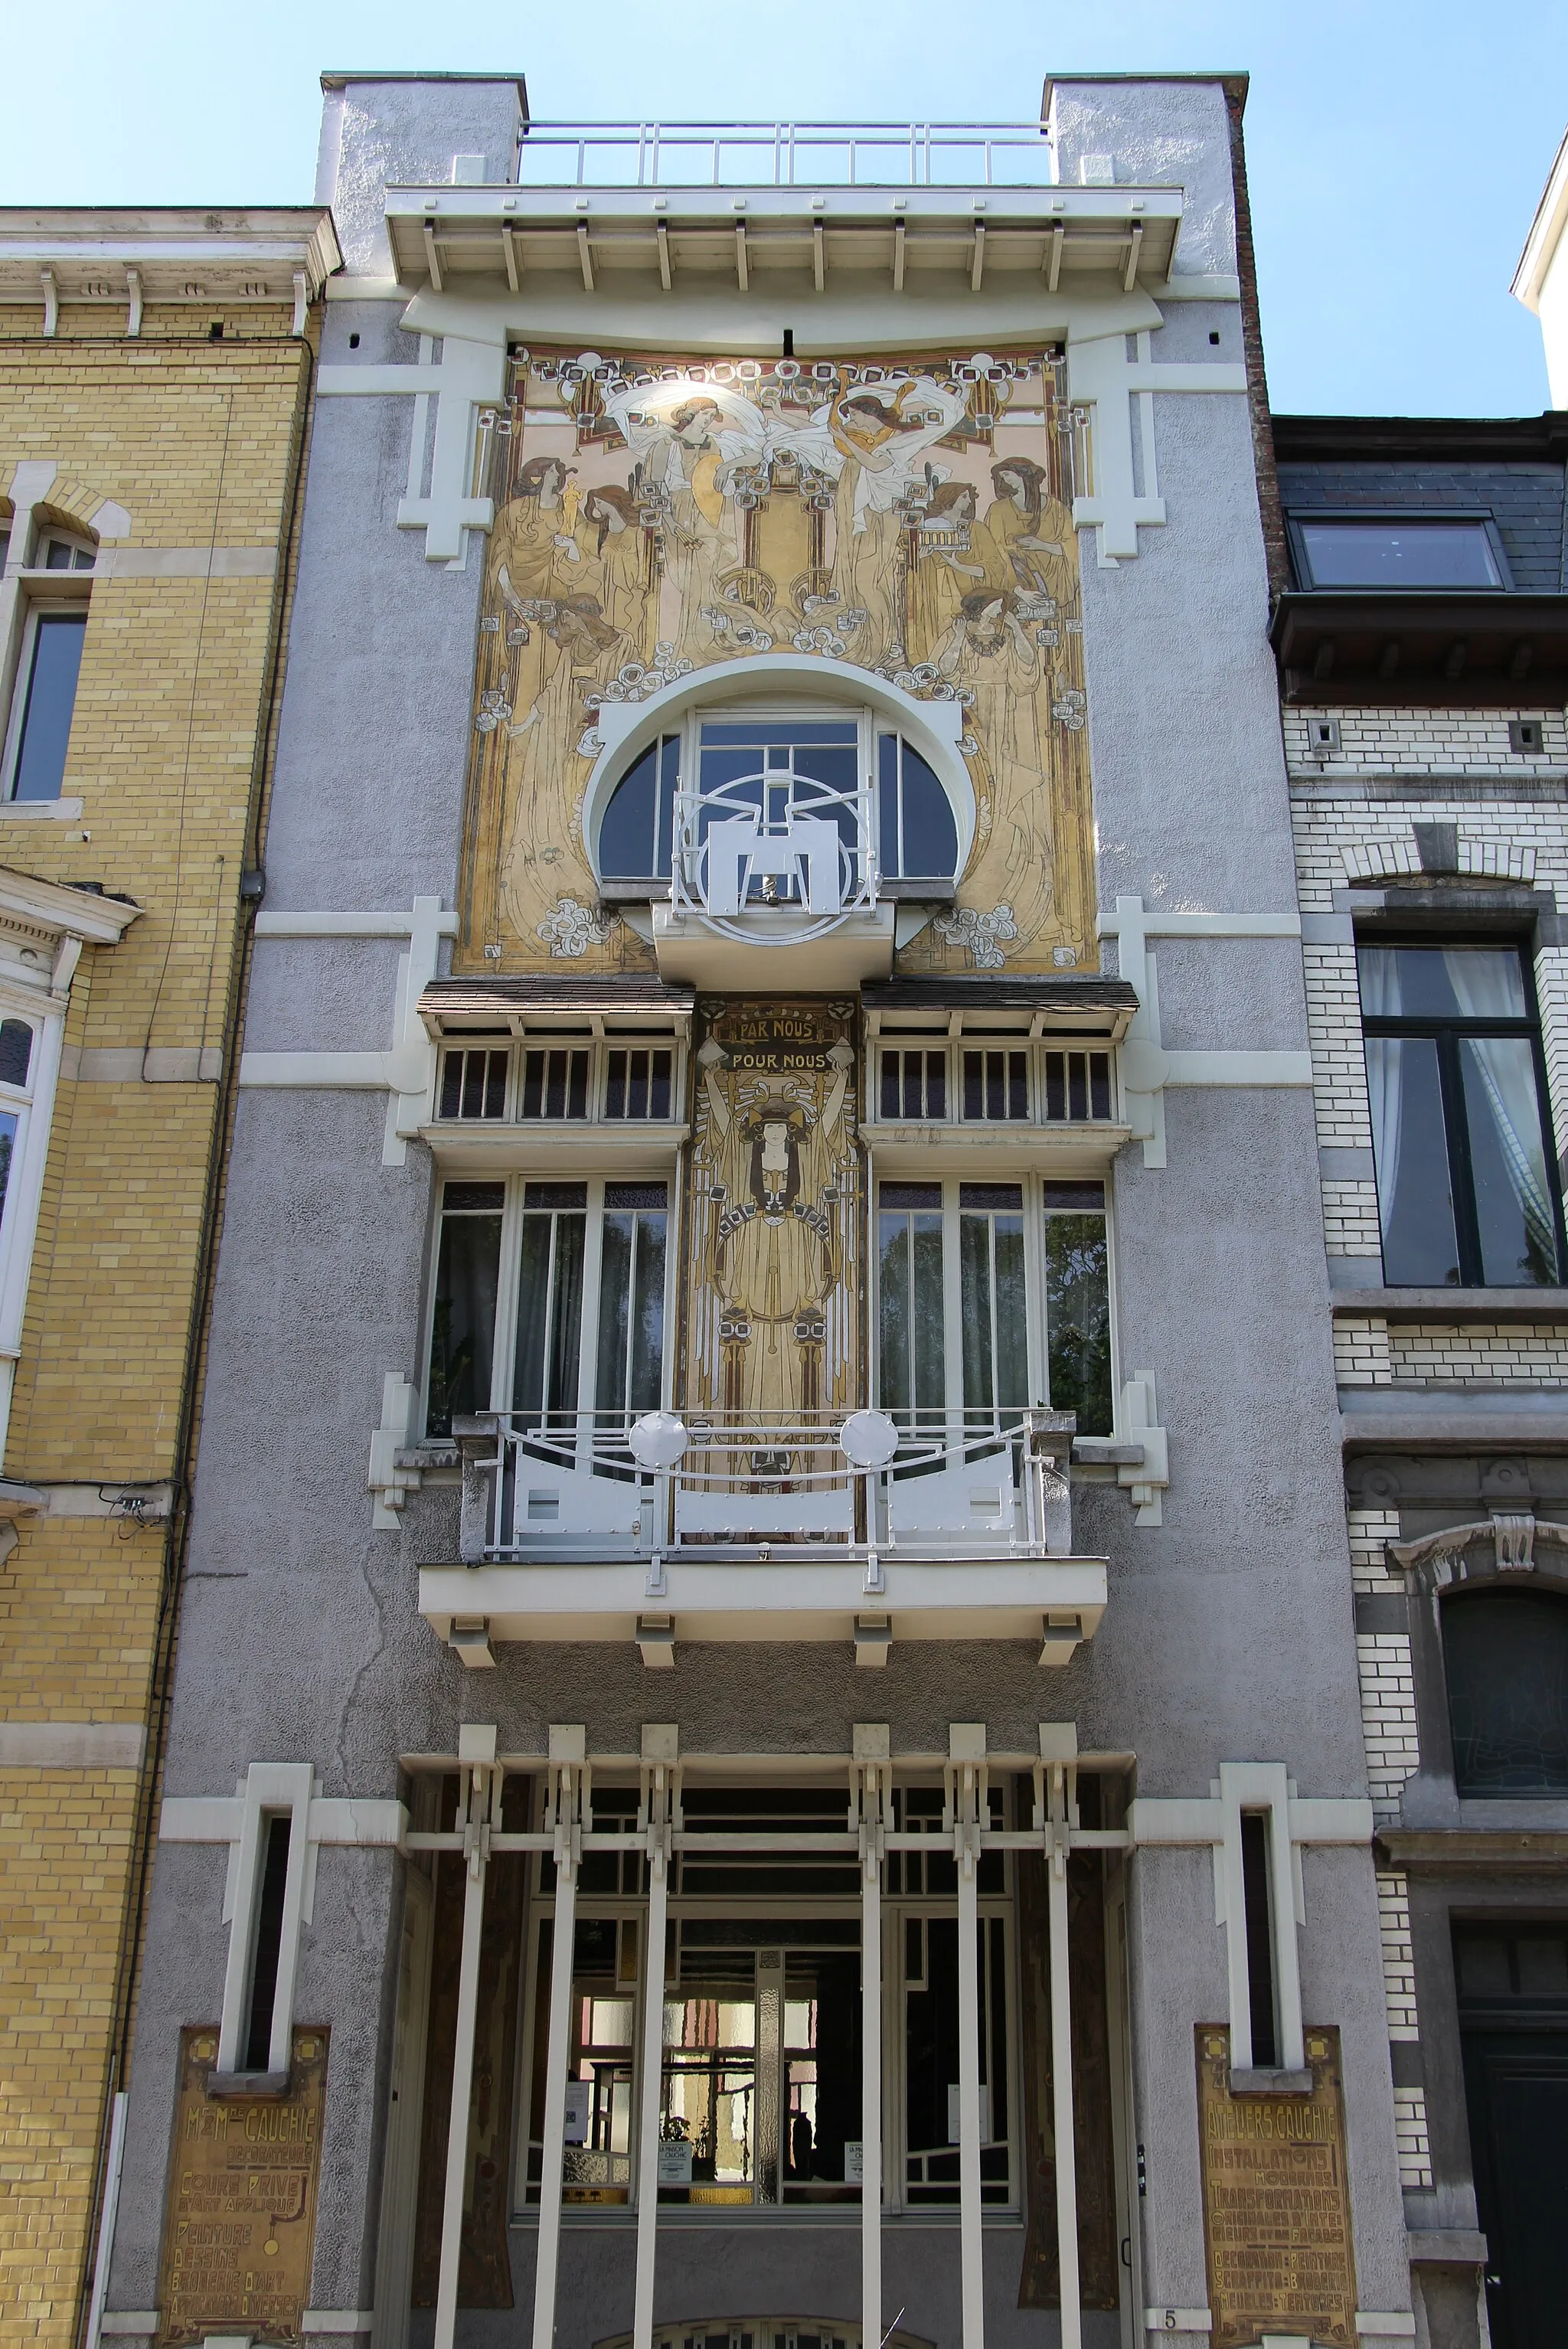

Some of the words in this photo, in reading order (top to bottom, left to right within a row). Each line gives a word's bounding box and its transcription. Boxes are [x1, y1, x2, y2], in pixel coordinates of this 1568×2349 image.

[741, 1021, 769, 1037] PAR
[773, 1020, 813, 1037] NOUS
[733, 1054, 779, 1068] POUR
[783, 1054, 825, 1068] NOUS
[245, 2106, 315, 2142] CAUCHIE
[1207, 2100, 1272, 2140] ATELIERS
[1276, 2105, 1337, 2142] CAUCHIE
[227, 2145, 312, 2164] DECORATEURS
[1208, 2145, 1328, 2171] INSTALLATIONS
[181, 2171, 240, 2196] COURS
[1255, 2171, 1332, 2187] MODERNES
[179, 2193, 221, 2212] D'ART
[225, 2197, 296, 2213] APPLIQUE
[1210, 2179, 1341, 2211] TRANSFORMATIONS
[1211, 2211, 1289, 2226] ORIGINALES
[175, 2218, 252, 2245] PEINTURE
[1213, 2226, 1257, 2243] RIEURS
[1292, 2228, 1344, 2244] FACADES
[174, 2247, 240, 2269] DESSINS
[1290, 2252, 1346, 2271] PEINTURE
[171, 2271, 241, 2292] BRODERIE
[1289, 2272, 1348, 2291] BRODERIE
[241, 2295, 298, 2316] DIVERSES
[1279, 2293, 1344, 2312] TENTURES
